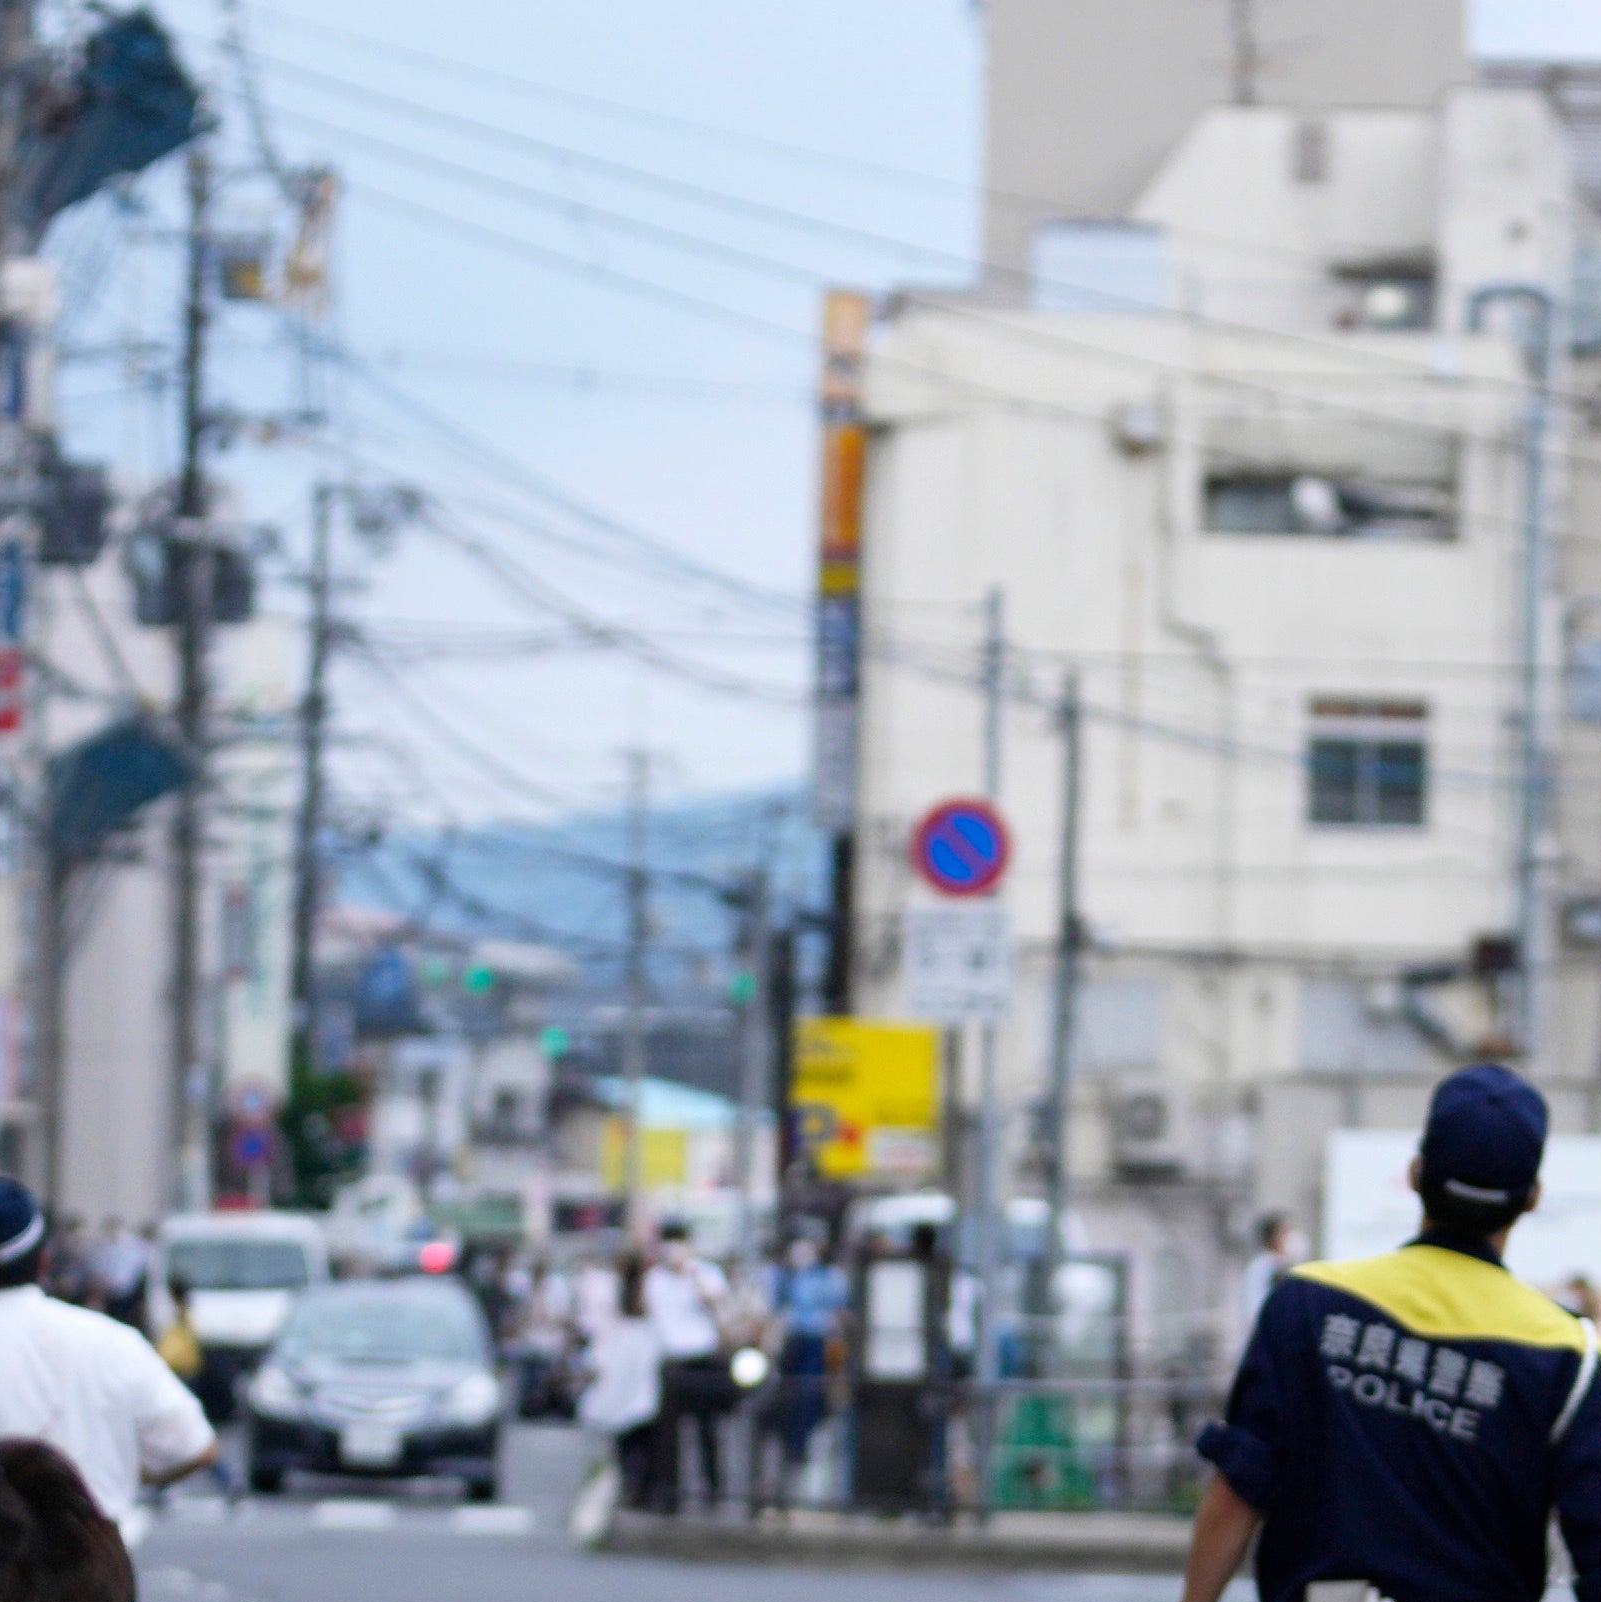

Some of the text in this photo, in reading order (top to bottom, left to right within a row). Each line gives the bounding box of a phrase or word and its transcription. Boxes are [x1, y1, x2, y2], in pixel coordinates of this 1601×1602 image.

[1320, 1312, 1506, 1409] 奈良県警察
[1326, 1365, 1483, 1442] POLICE
